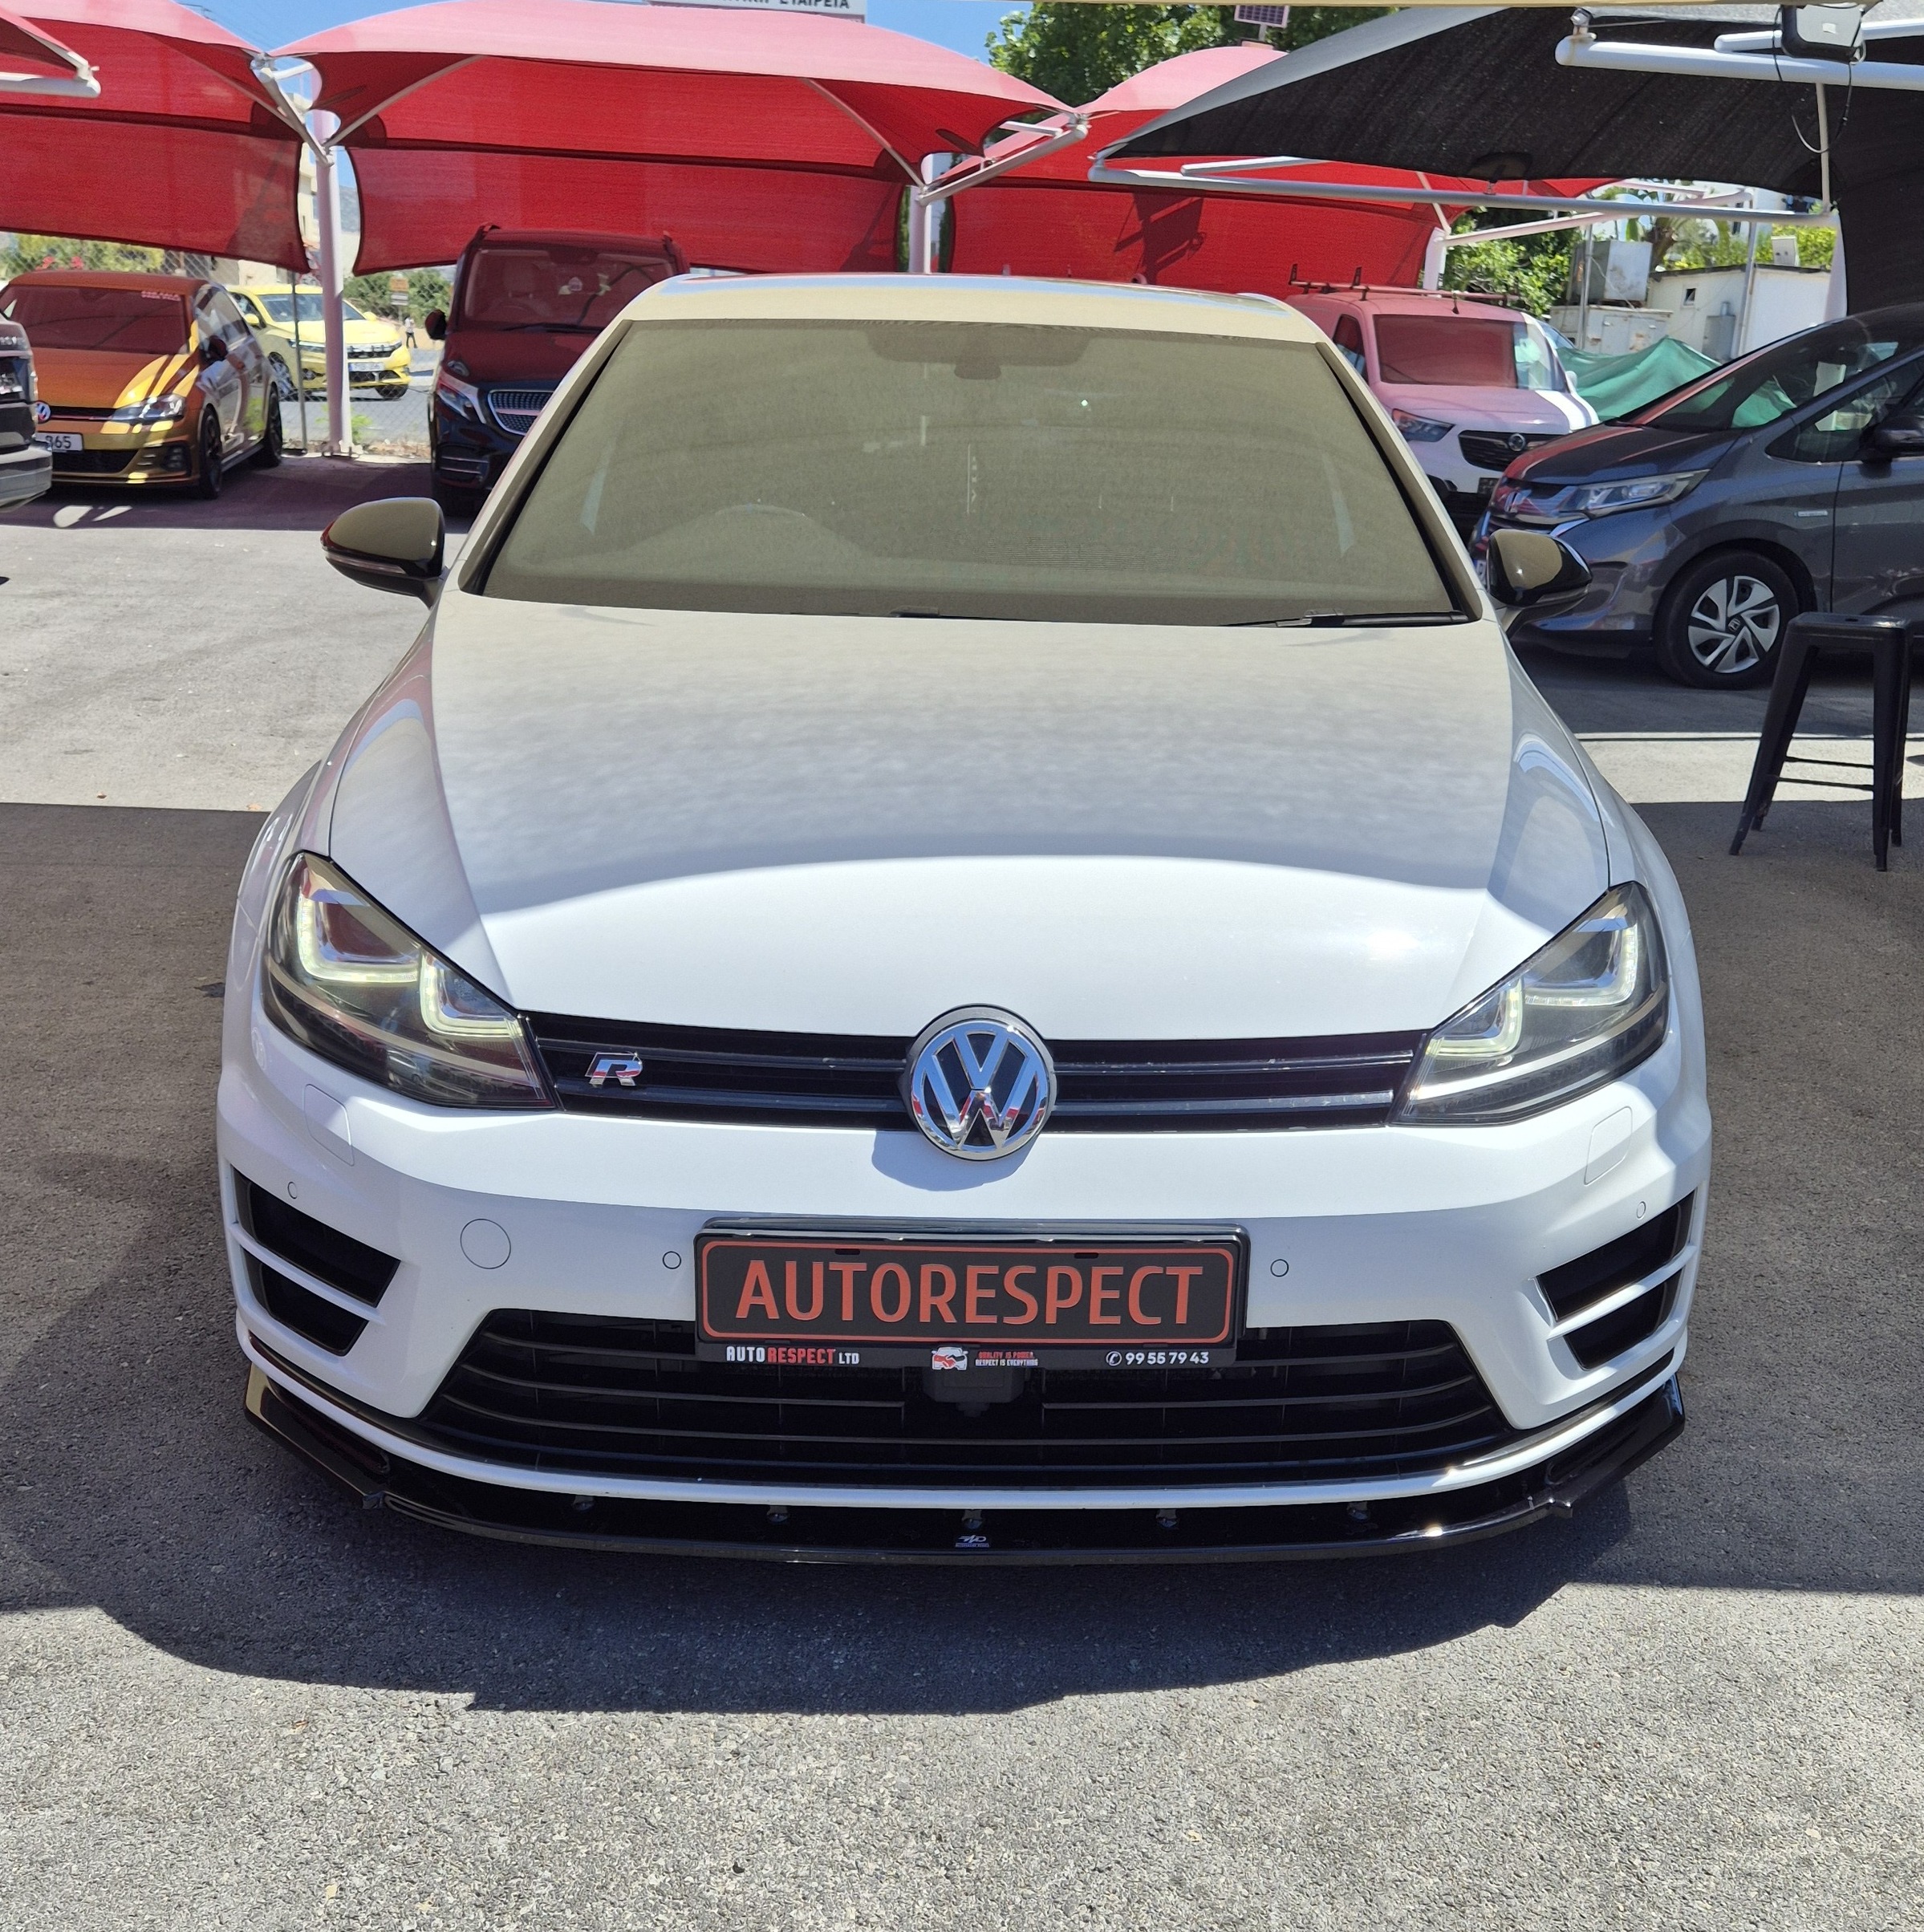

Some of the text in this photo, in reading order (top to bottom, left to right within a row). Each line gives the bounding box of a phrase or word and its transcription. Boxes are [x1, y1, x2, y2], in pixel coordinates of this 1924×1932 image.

[585, 1052, 643, 1087] R
[736, 1260, 1204, 1325] AUTORESPECT
[838, 1352, 859, 1365] LTD
